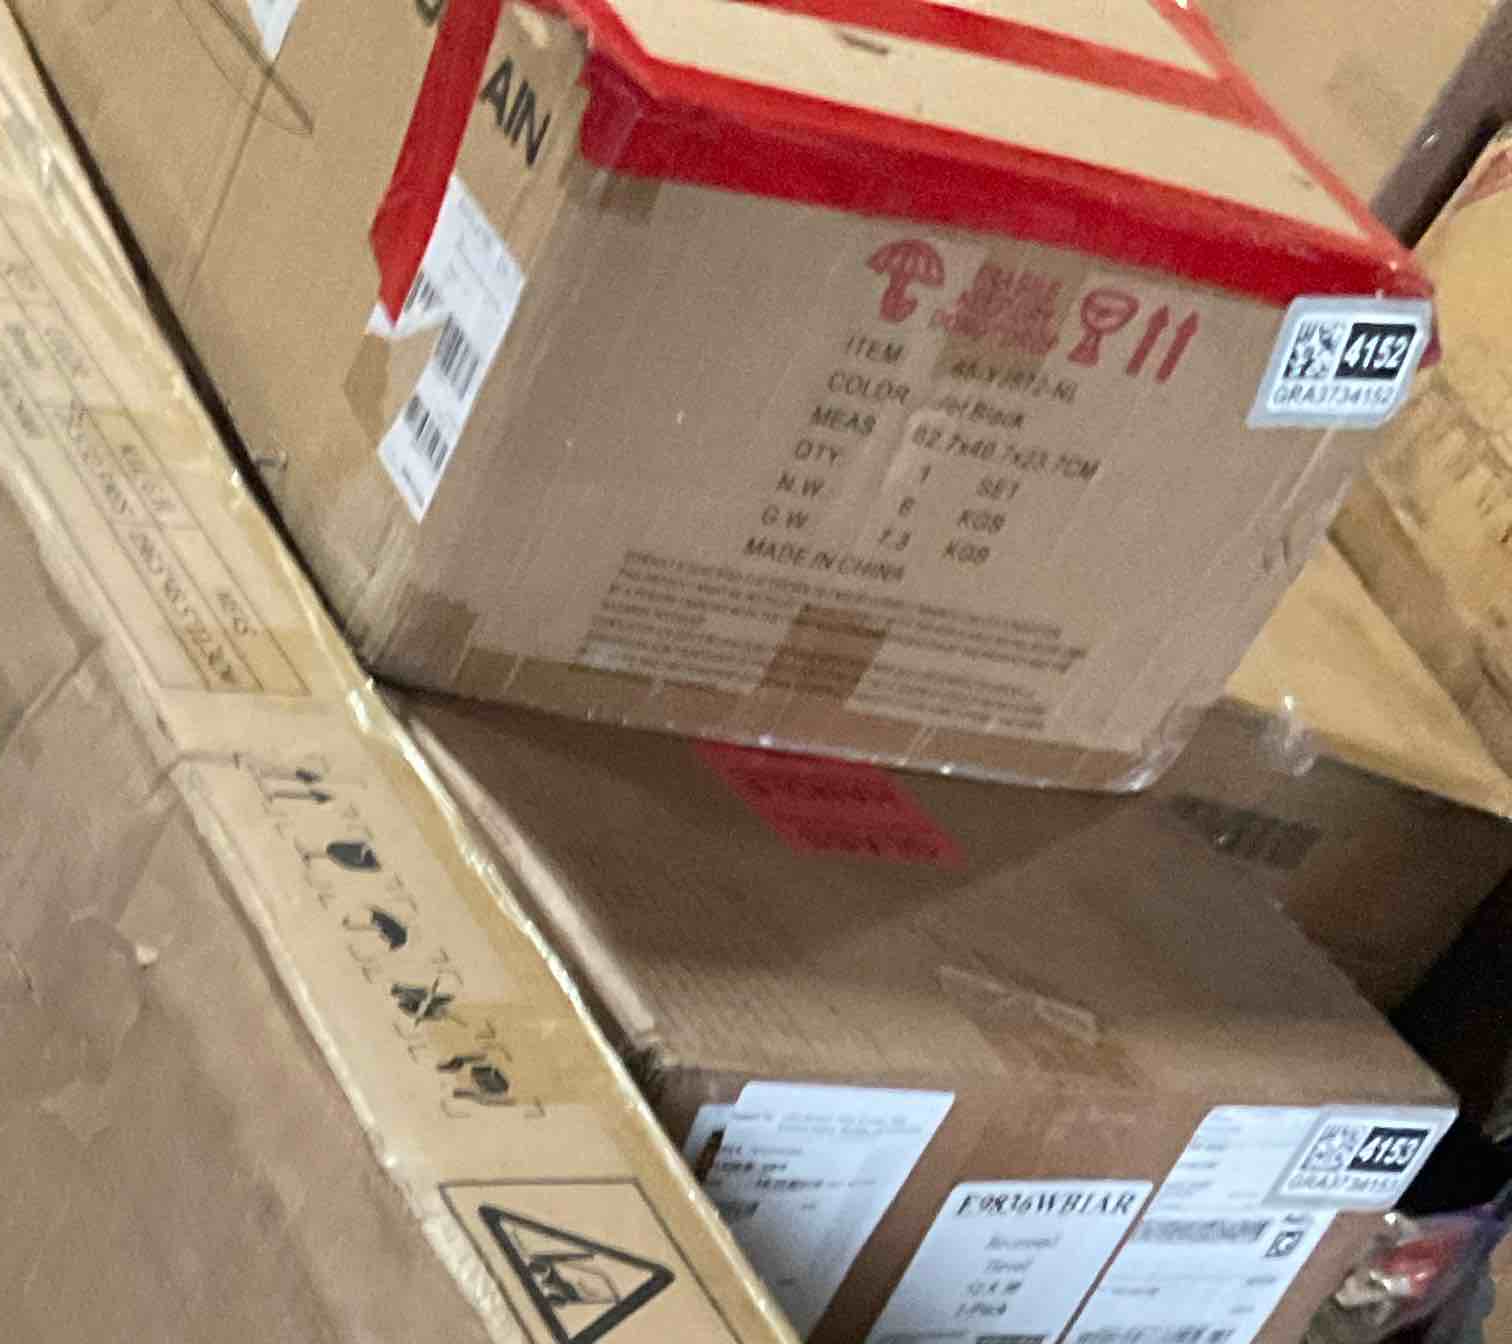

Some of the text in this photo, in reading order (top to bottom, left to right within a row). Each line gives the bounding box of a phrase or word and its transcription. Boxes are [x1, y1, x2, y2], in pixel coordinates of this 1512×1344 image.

[480, 57, 550, 166] AIN
[1343, 333, 1410, 370] 4152
[745, 537, 905, 582] MADE IN CHINA
[1358, 1135, 1420, 1165] 4153
